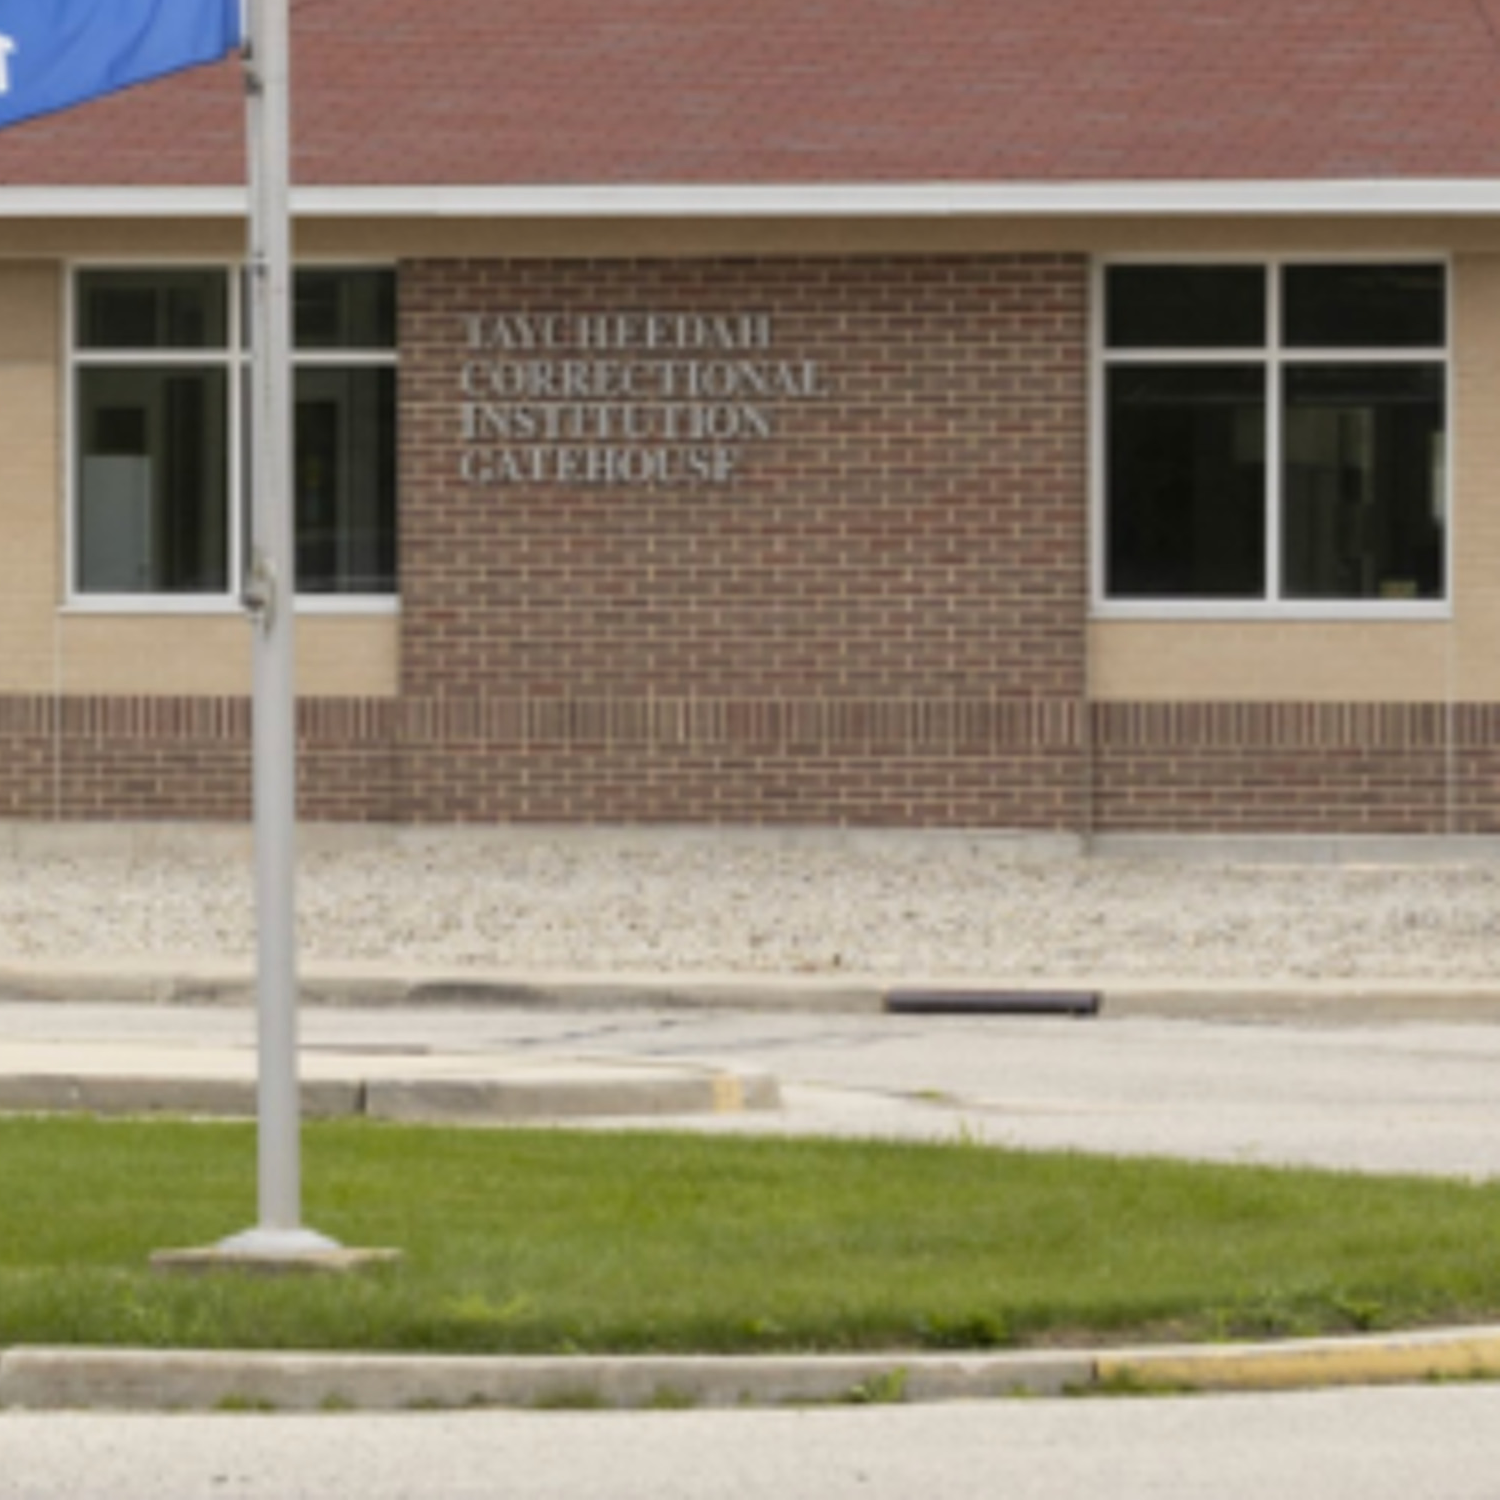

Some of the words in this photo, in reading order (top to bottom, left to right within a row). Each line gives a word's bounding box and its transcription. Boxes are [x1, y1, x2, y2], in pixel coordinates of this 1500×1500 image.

[463, 312, 771, 350] TAYCHEEDAH
[461, 359, 829, 397] CORRECTIONAL
[461, 401, 772, 440] INSTITUTION
[460, 446, 740, 484] GATEHOUSE
